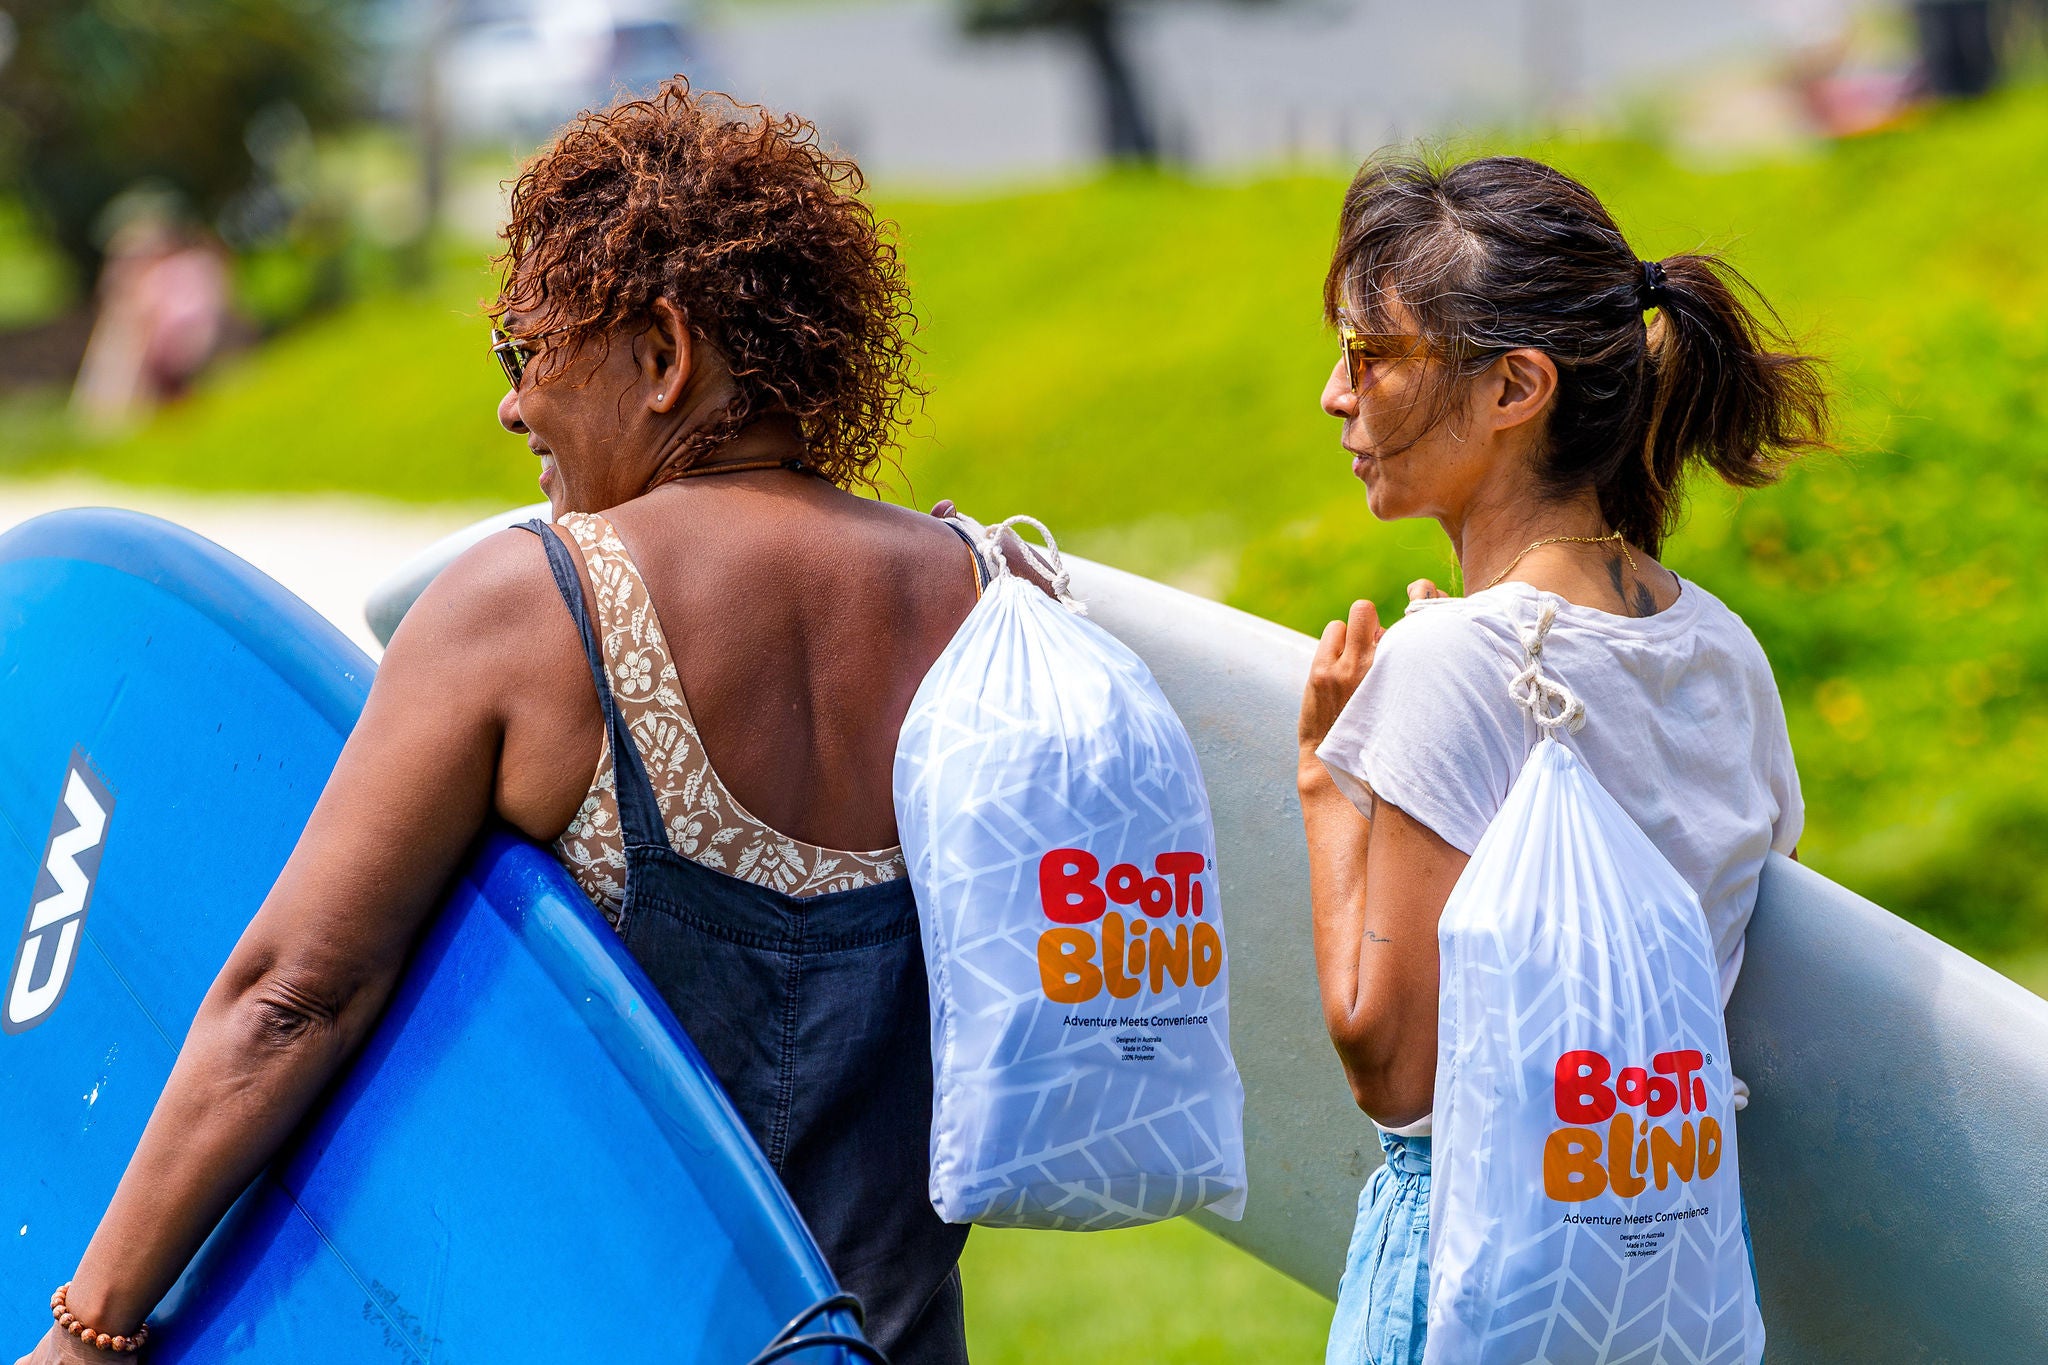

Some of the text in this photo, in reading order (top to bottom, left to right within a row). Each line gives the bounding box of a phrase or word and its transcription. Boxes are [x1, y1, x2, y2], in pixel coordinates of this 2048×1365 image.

[9, 768, 107, 1024] CW
[1063, 1014, 1208, 1027] Adventure Meets Convenience
[1116, 1036, 1137, 1044] Designed
[1563, 1206, 1709, 1226] Adventure Meets Convenience
[1619, 1234, 1641, 1242] Designed
[1646, 1231, 1665, 1239] Australia
[1637, 1249, 1658, 1257] Polyester
